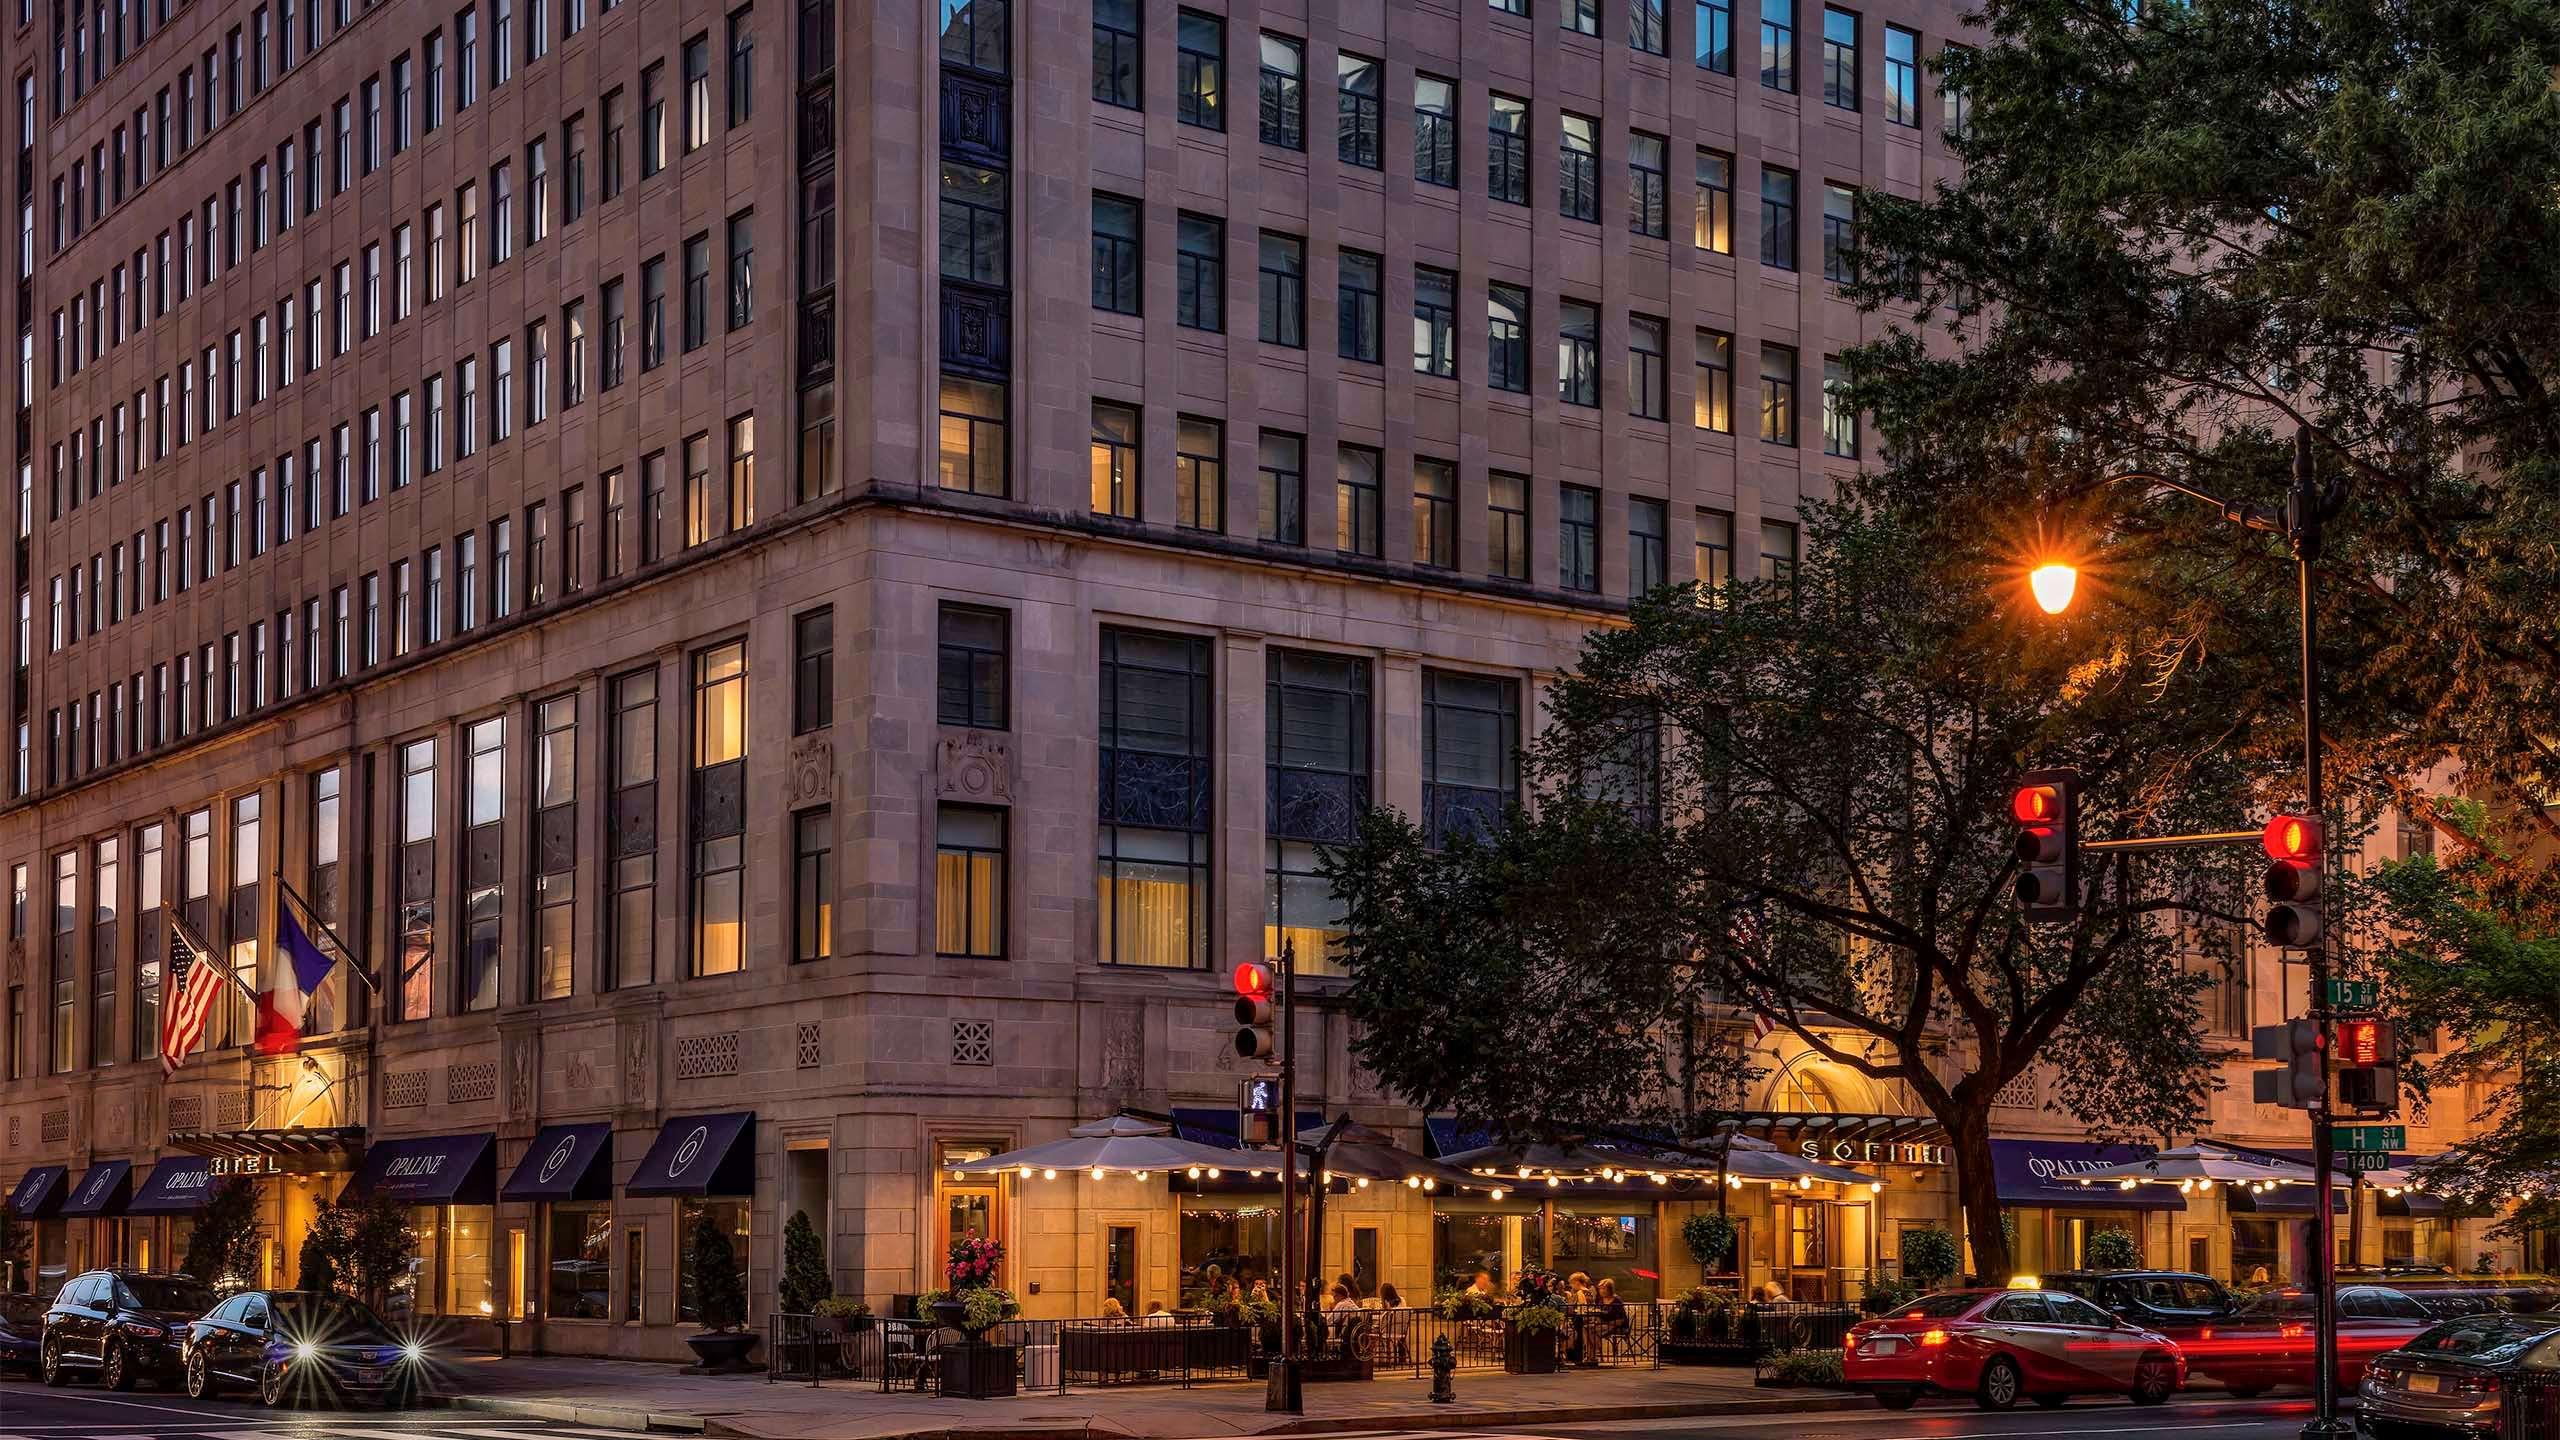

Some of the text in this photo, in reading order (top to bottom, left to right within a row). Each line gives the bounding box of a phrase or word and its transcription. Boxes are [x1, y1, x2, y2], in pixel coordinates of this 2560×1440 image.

[2336, 982, 2373, 1005] 15 ST NW
[2352, 1127, 2399, 1149] H ST NW
[386, 1155, 446, 1176] OPALINE
[2352, 1155, 2385, 1169] 1400
